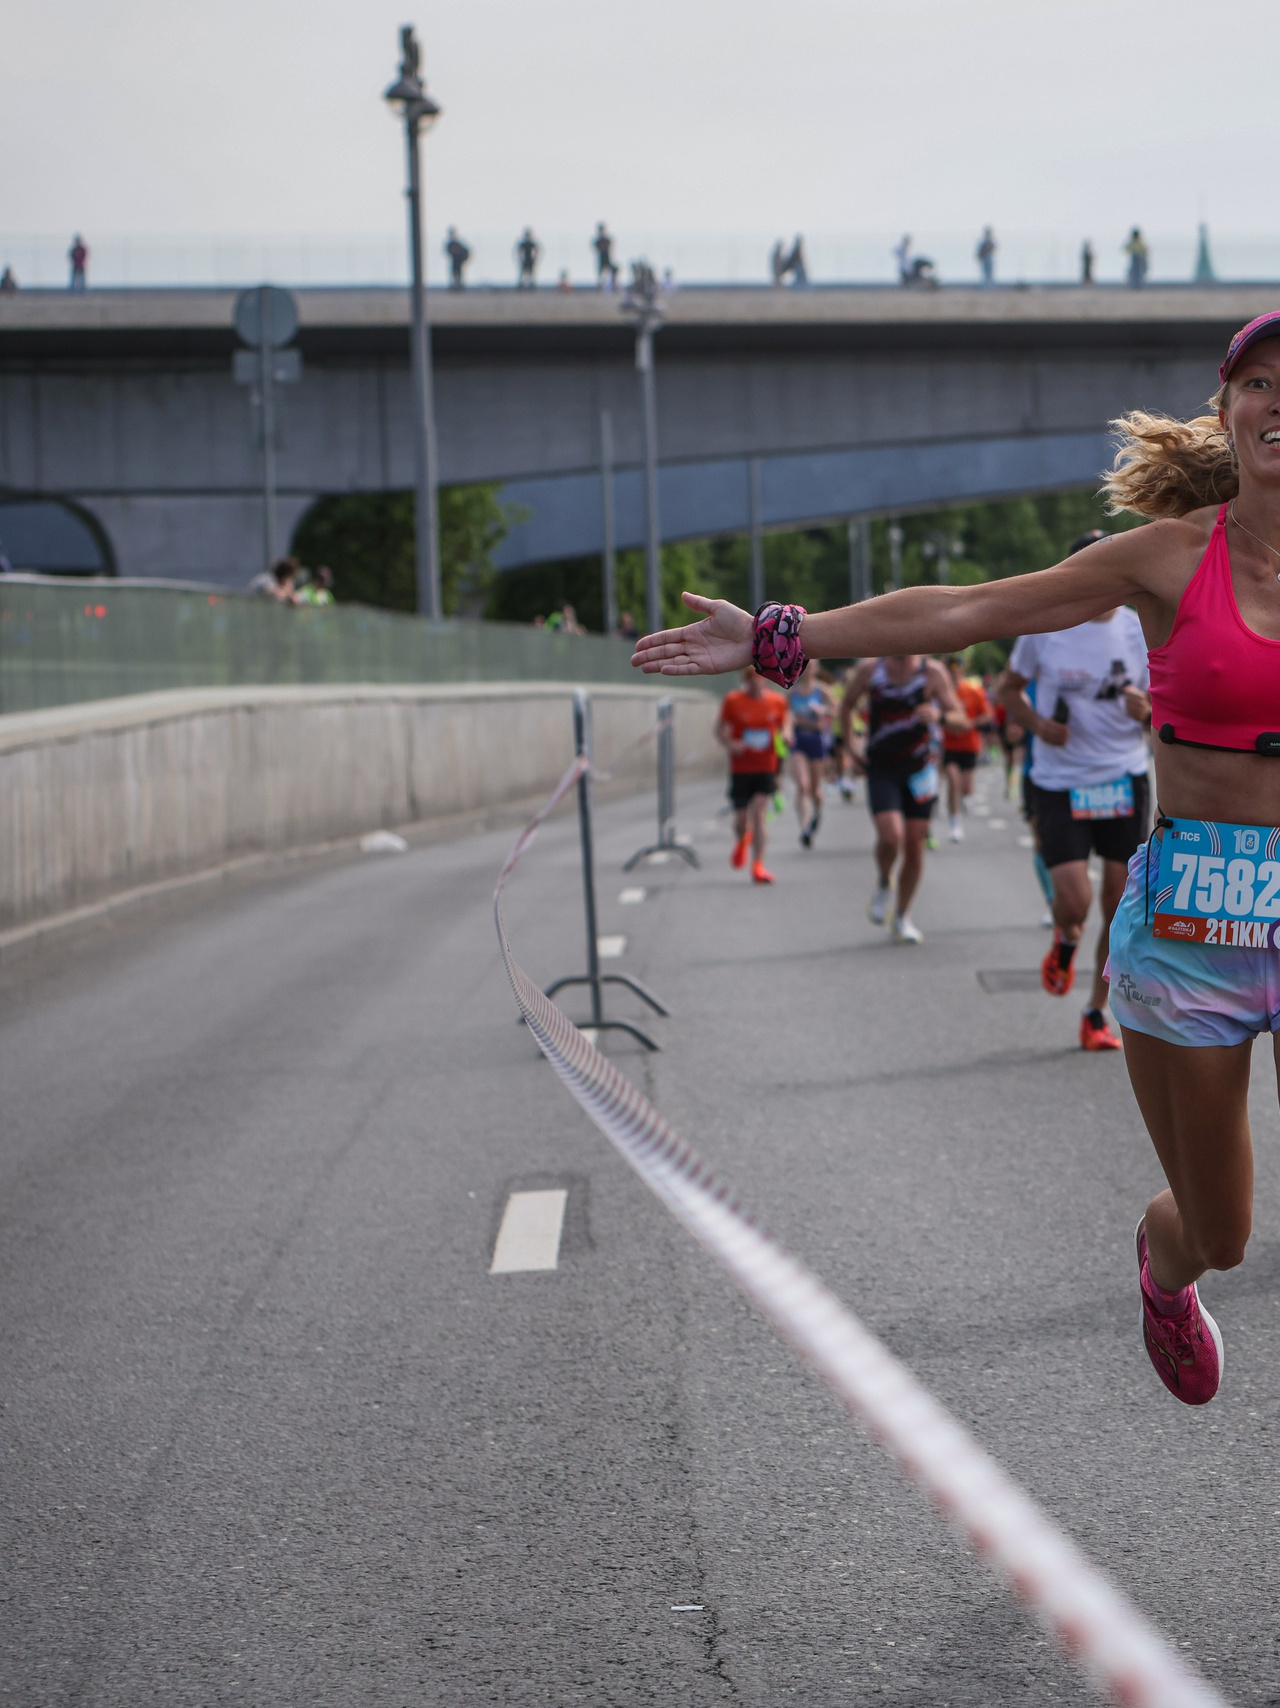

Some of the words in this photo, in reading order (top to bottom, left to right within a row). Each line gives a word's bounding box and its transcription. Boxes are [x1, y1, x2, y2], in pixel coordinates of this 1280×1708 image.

[1180, 831, 1200, 842] ПСБ
[1233, 829, 1260, 855] 10
[1204, 917, 1271, 949] 21.1KM
